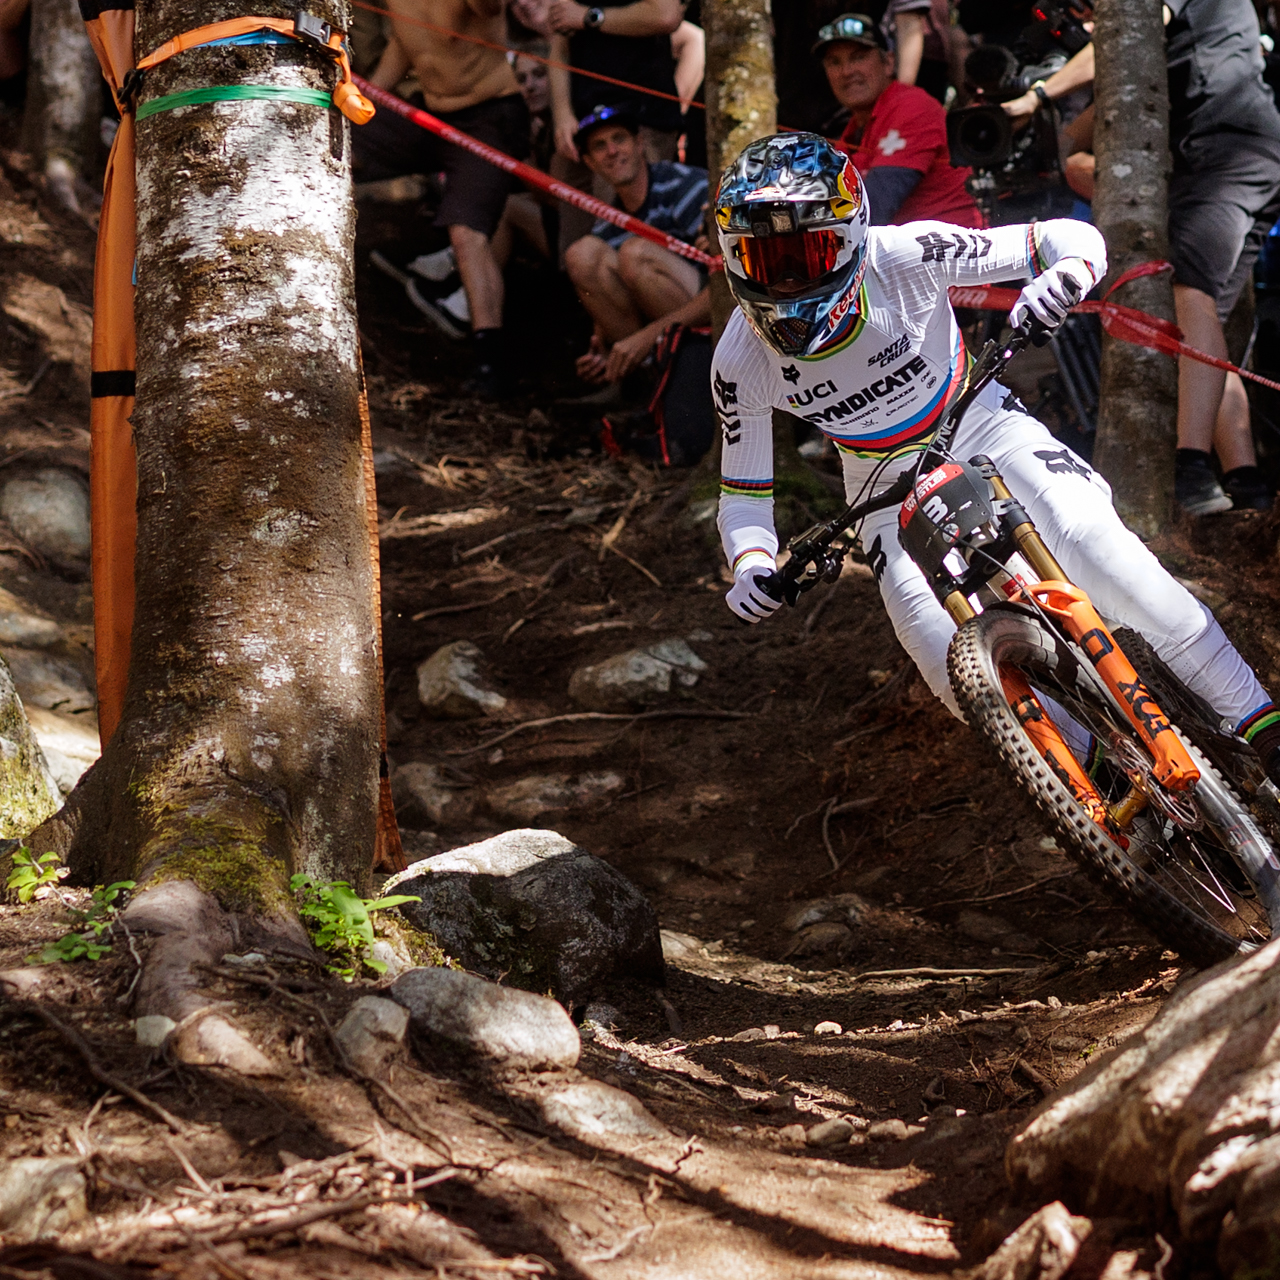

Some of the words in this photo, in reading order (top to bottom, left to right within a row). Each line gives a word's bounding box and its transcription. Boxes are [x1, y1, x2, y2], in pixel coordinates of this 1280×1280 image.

[868, 332, 910, 368] SANTA
[879, 339, 912, 369] CRUZ
[794, 379, 839, 407] UCI
[801, 354, 928, 425] SYNDICATE
[922, 495, 949, 525] 3
[1116, 675, 1172, 741] FOX
